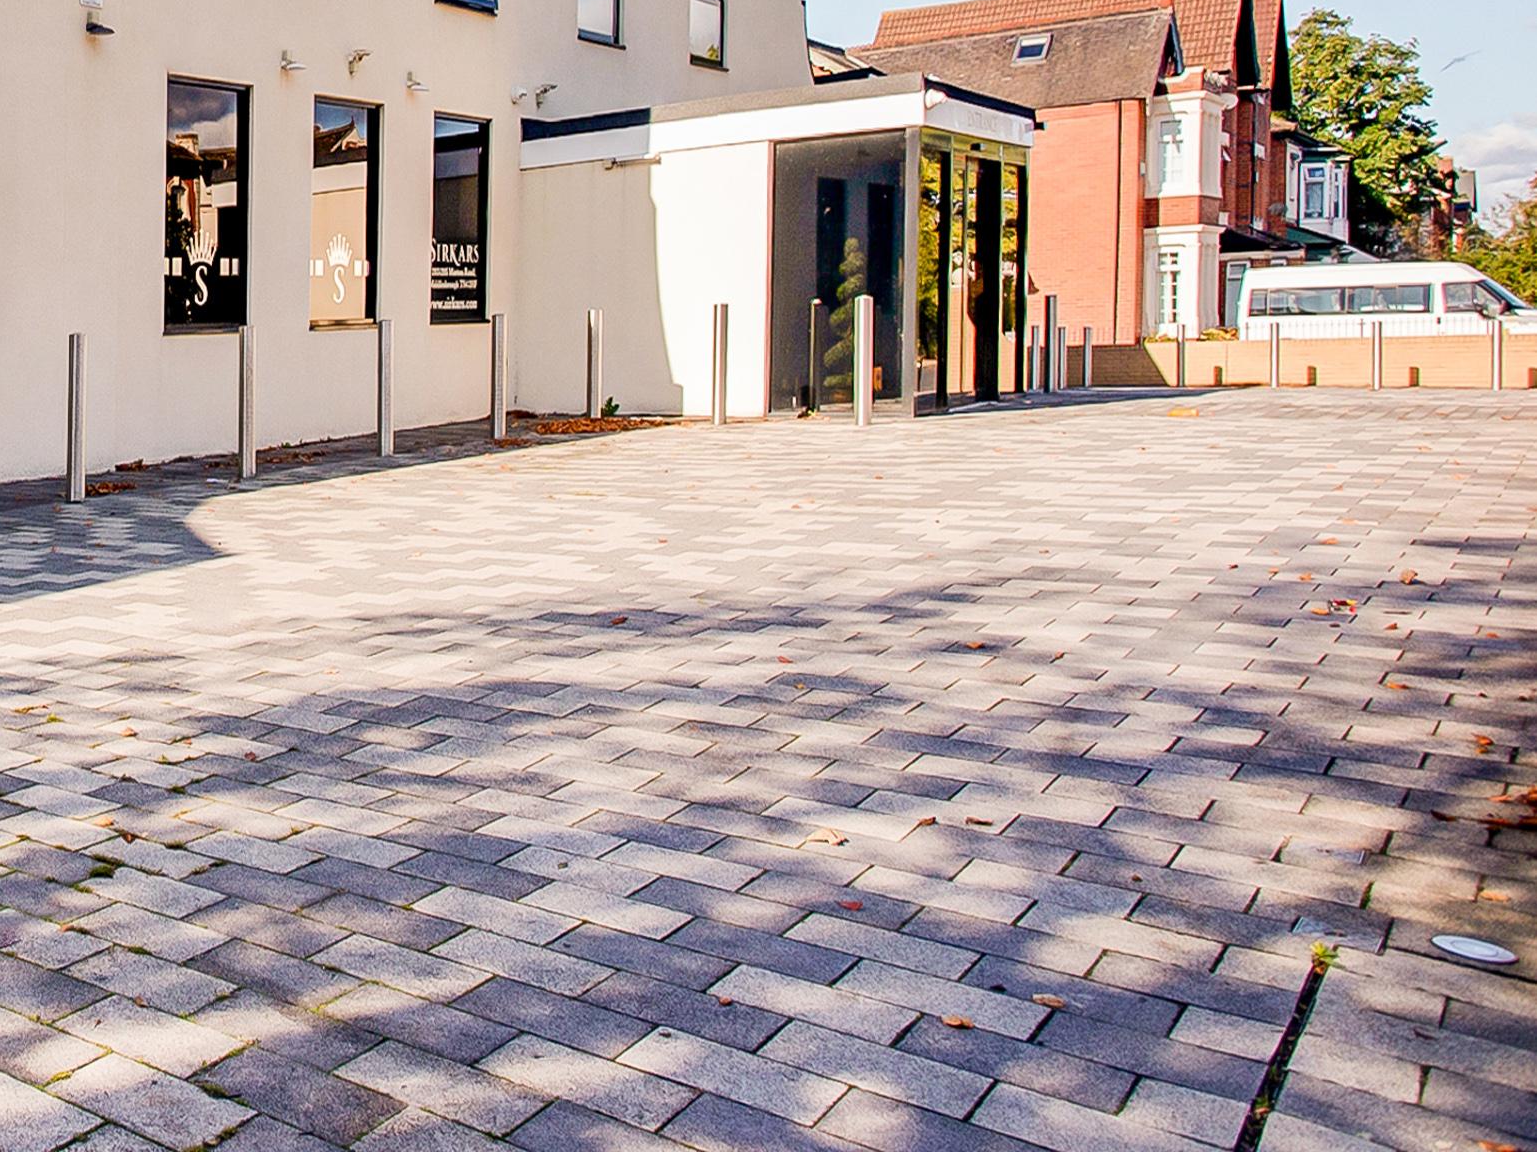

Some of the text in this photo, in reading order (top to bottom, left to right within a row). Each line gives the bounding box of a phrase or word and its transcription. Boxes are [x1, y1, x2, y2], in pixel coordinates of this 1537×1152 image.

[431, 238, 480, 267] SIRKARS
[195, 265, 209, 306] S
[333, 265, 345, 304] S
